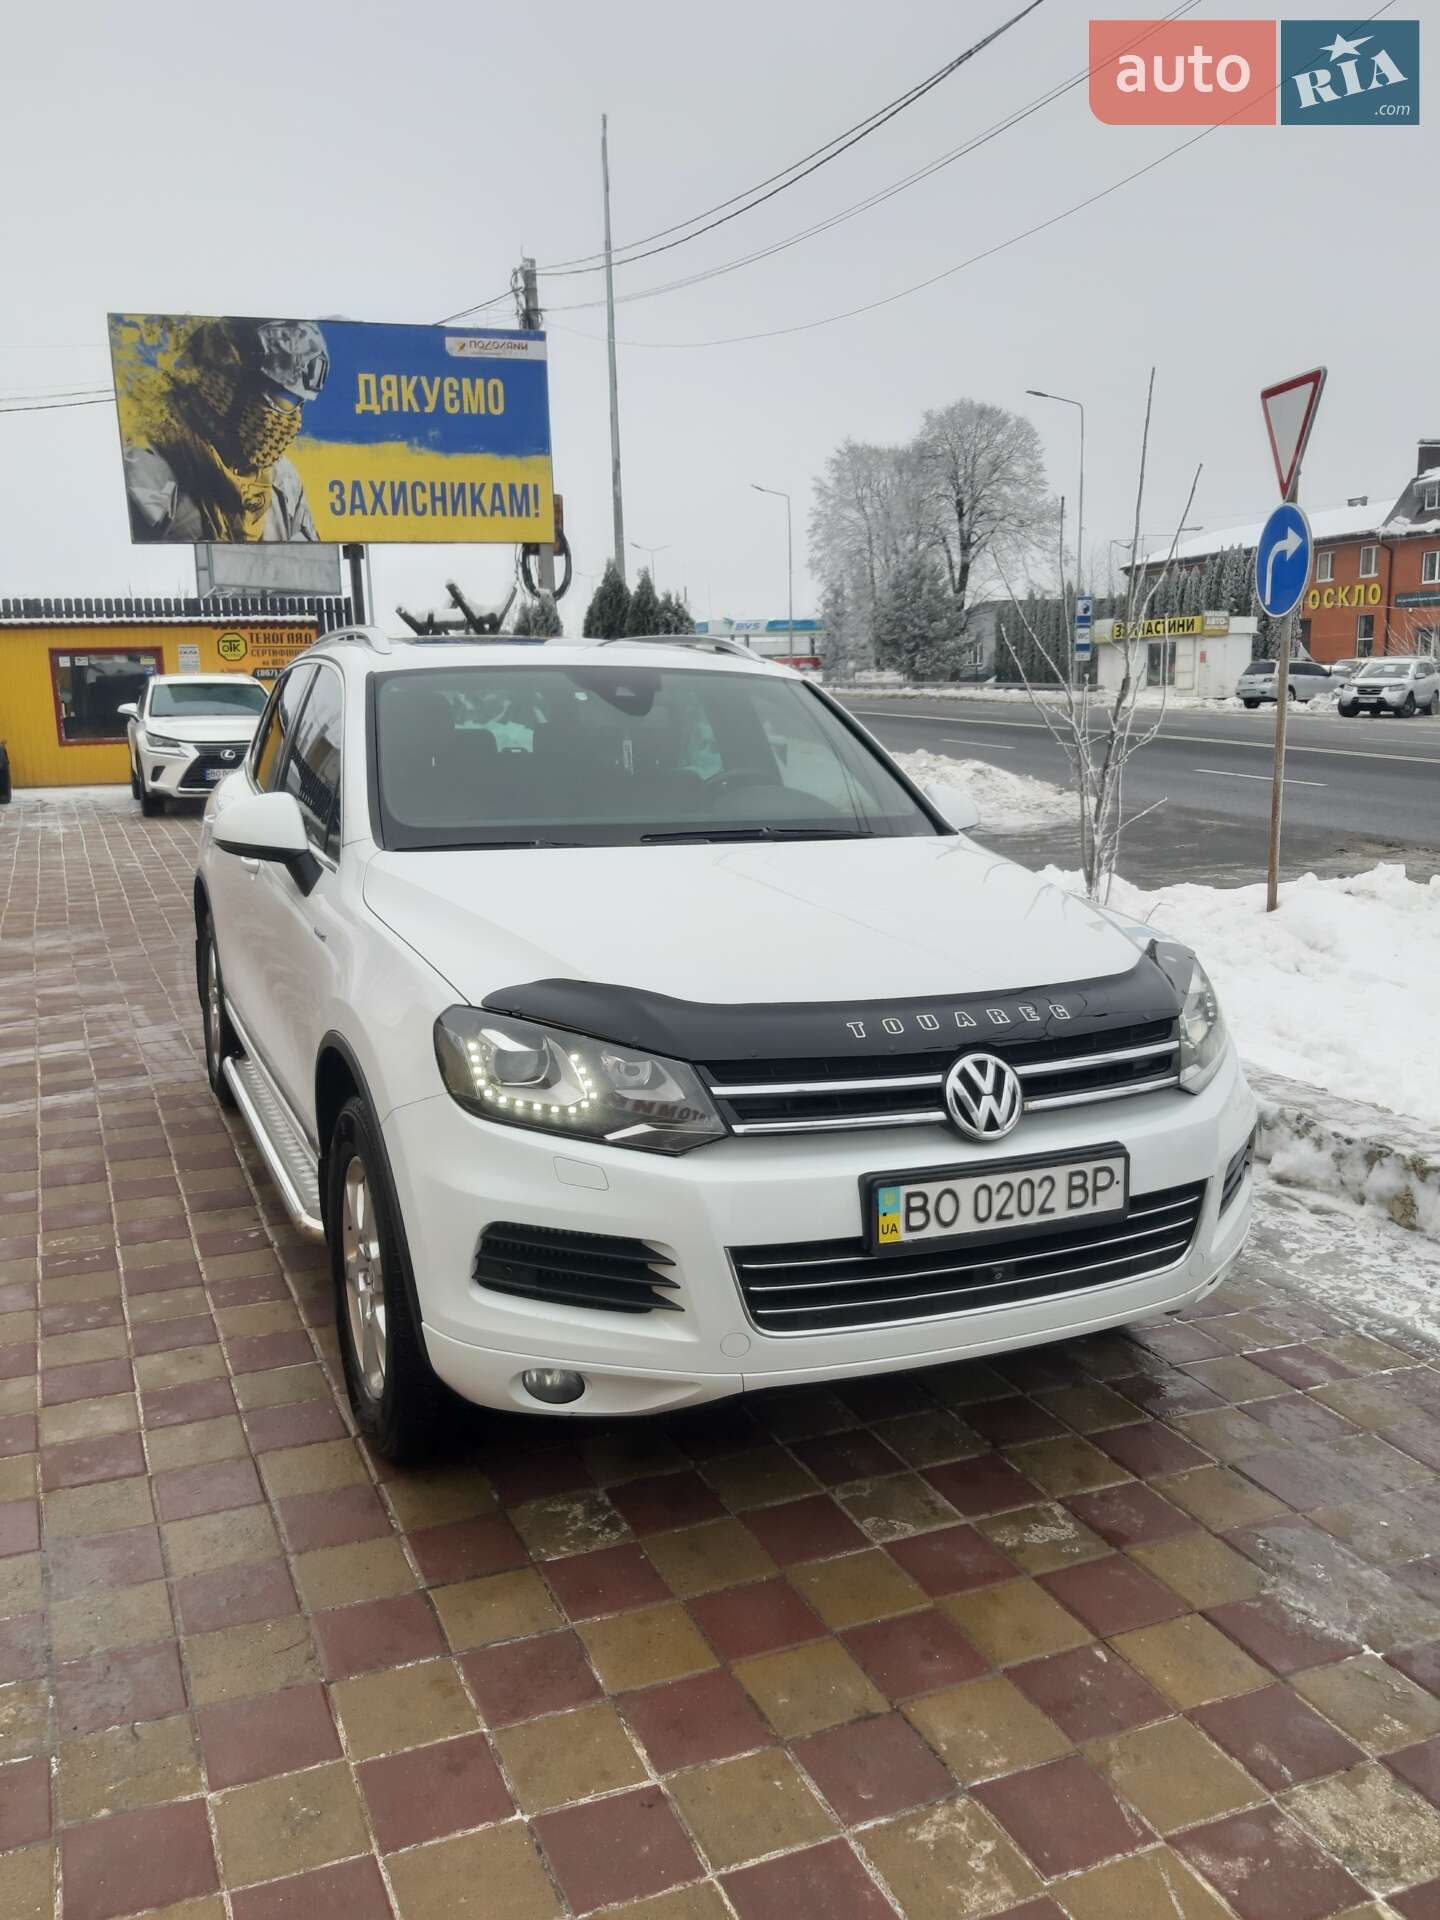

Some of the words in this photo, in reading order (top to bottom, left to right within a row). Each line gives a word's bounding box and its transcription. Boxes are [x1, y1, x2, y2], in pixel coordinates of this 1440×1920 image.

[355, 372, 505, 416] ДЯКУЄМО
[328, 479, 541, 518] ЗАХИСНИКАМ!
[1307, 582, 1381, 610] ОСКЛО
[846, 1004, 1071, 1038] TOUAREG
[904, 1187, 960, 1233] BO
[973, 1174, 1056, 1224] 0202
[1067, 1164, 1115, 1210] BP
[881, 1222, 899, 1235] UA
